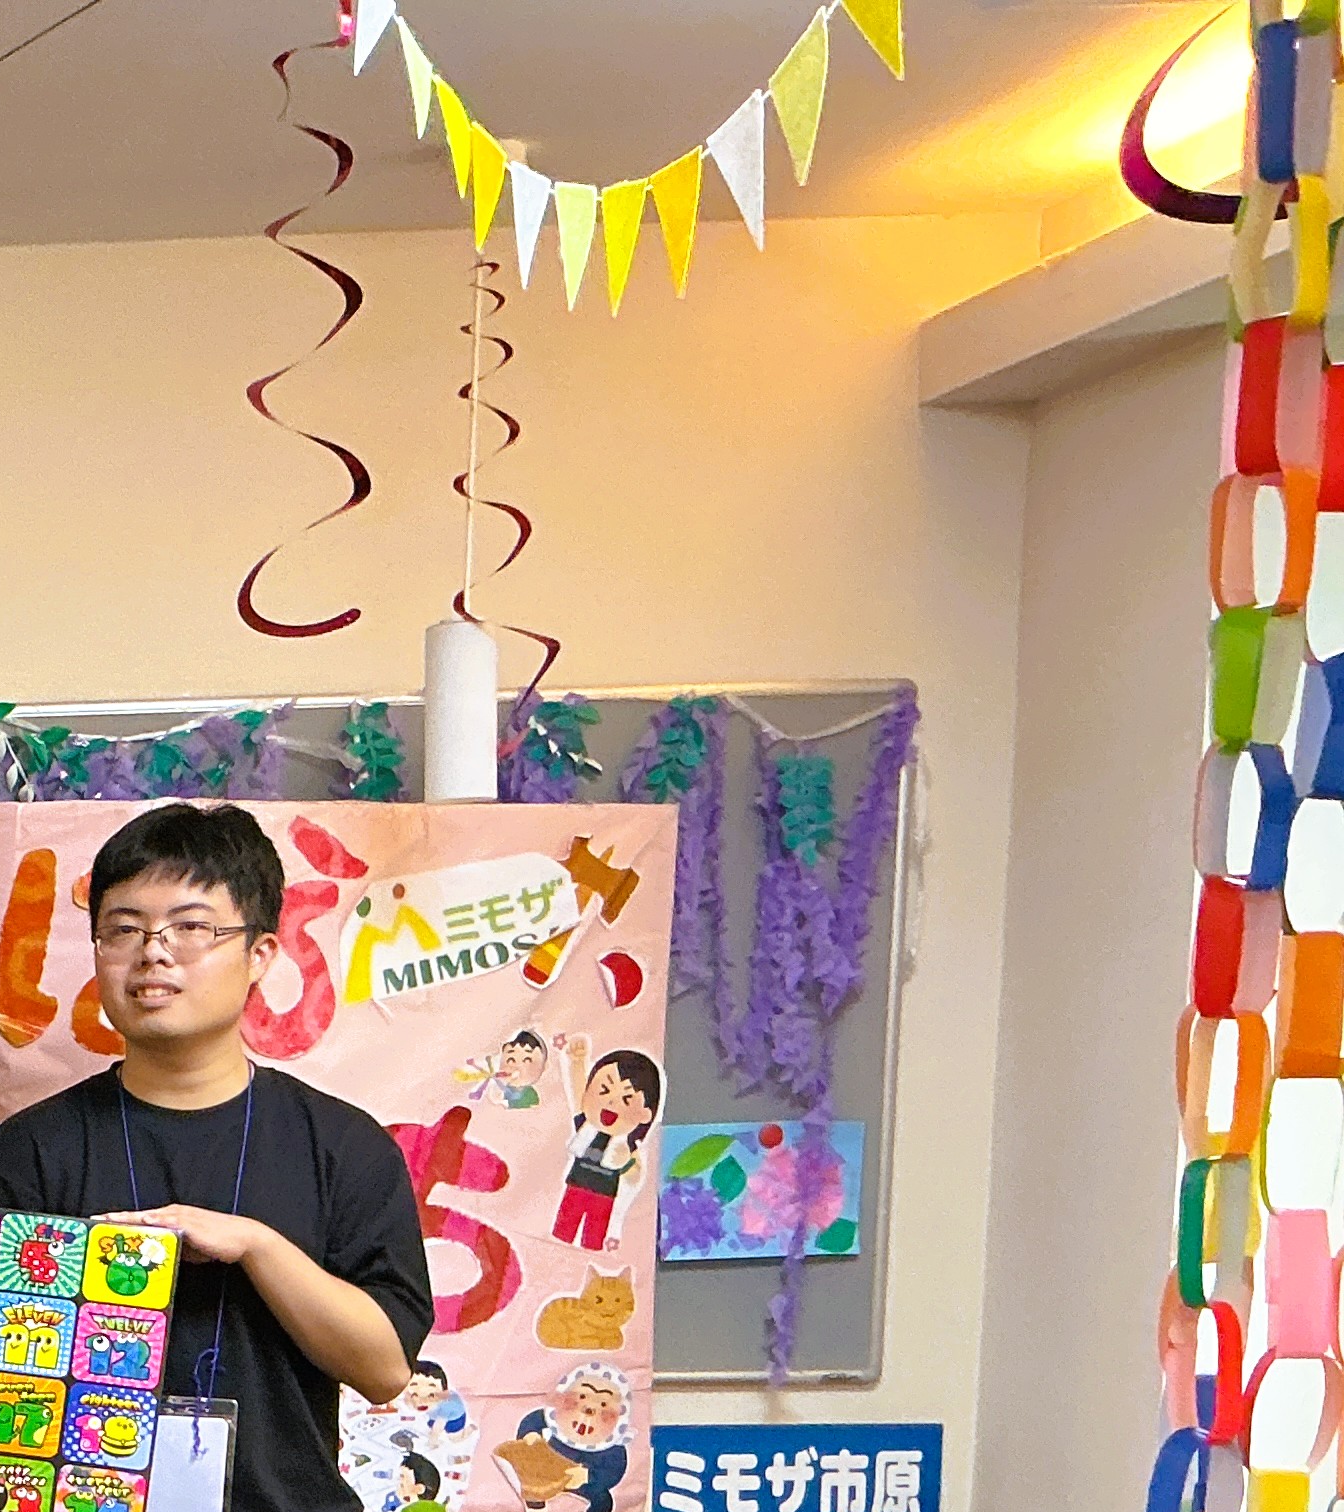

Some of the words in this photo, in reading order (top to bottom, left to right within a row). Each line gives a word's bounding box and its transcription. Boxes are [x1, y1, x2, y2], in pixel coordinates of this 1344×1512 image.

[443, 878, 562, 943] ミモザ
[383, 926, 559, 993] MIMOS
[19, 1240, 59, 1284] 5
[0, 1304, 68, 1327] ELEVEN
[90, 1313, 156, 1334] TWELVE
[85, 1333, 151, 1380] 12
